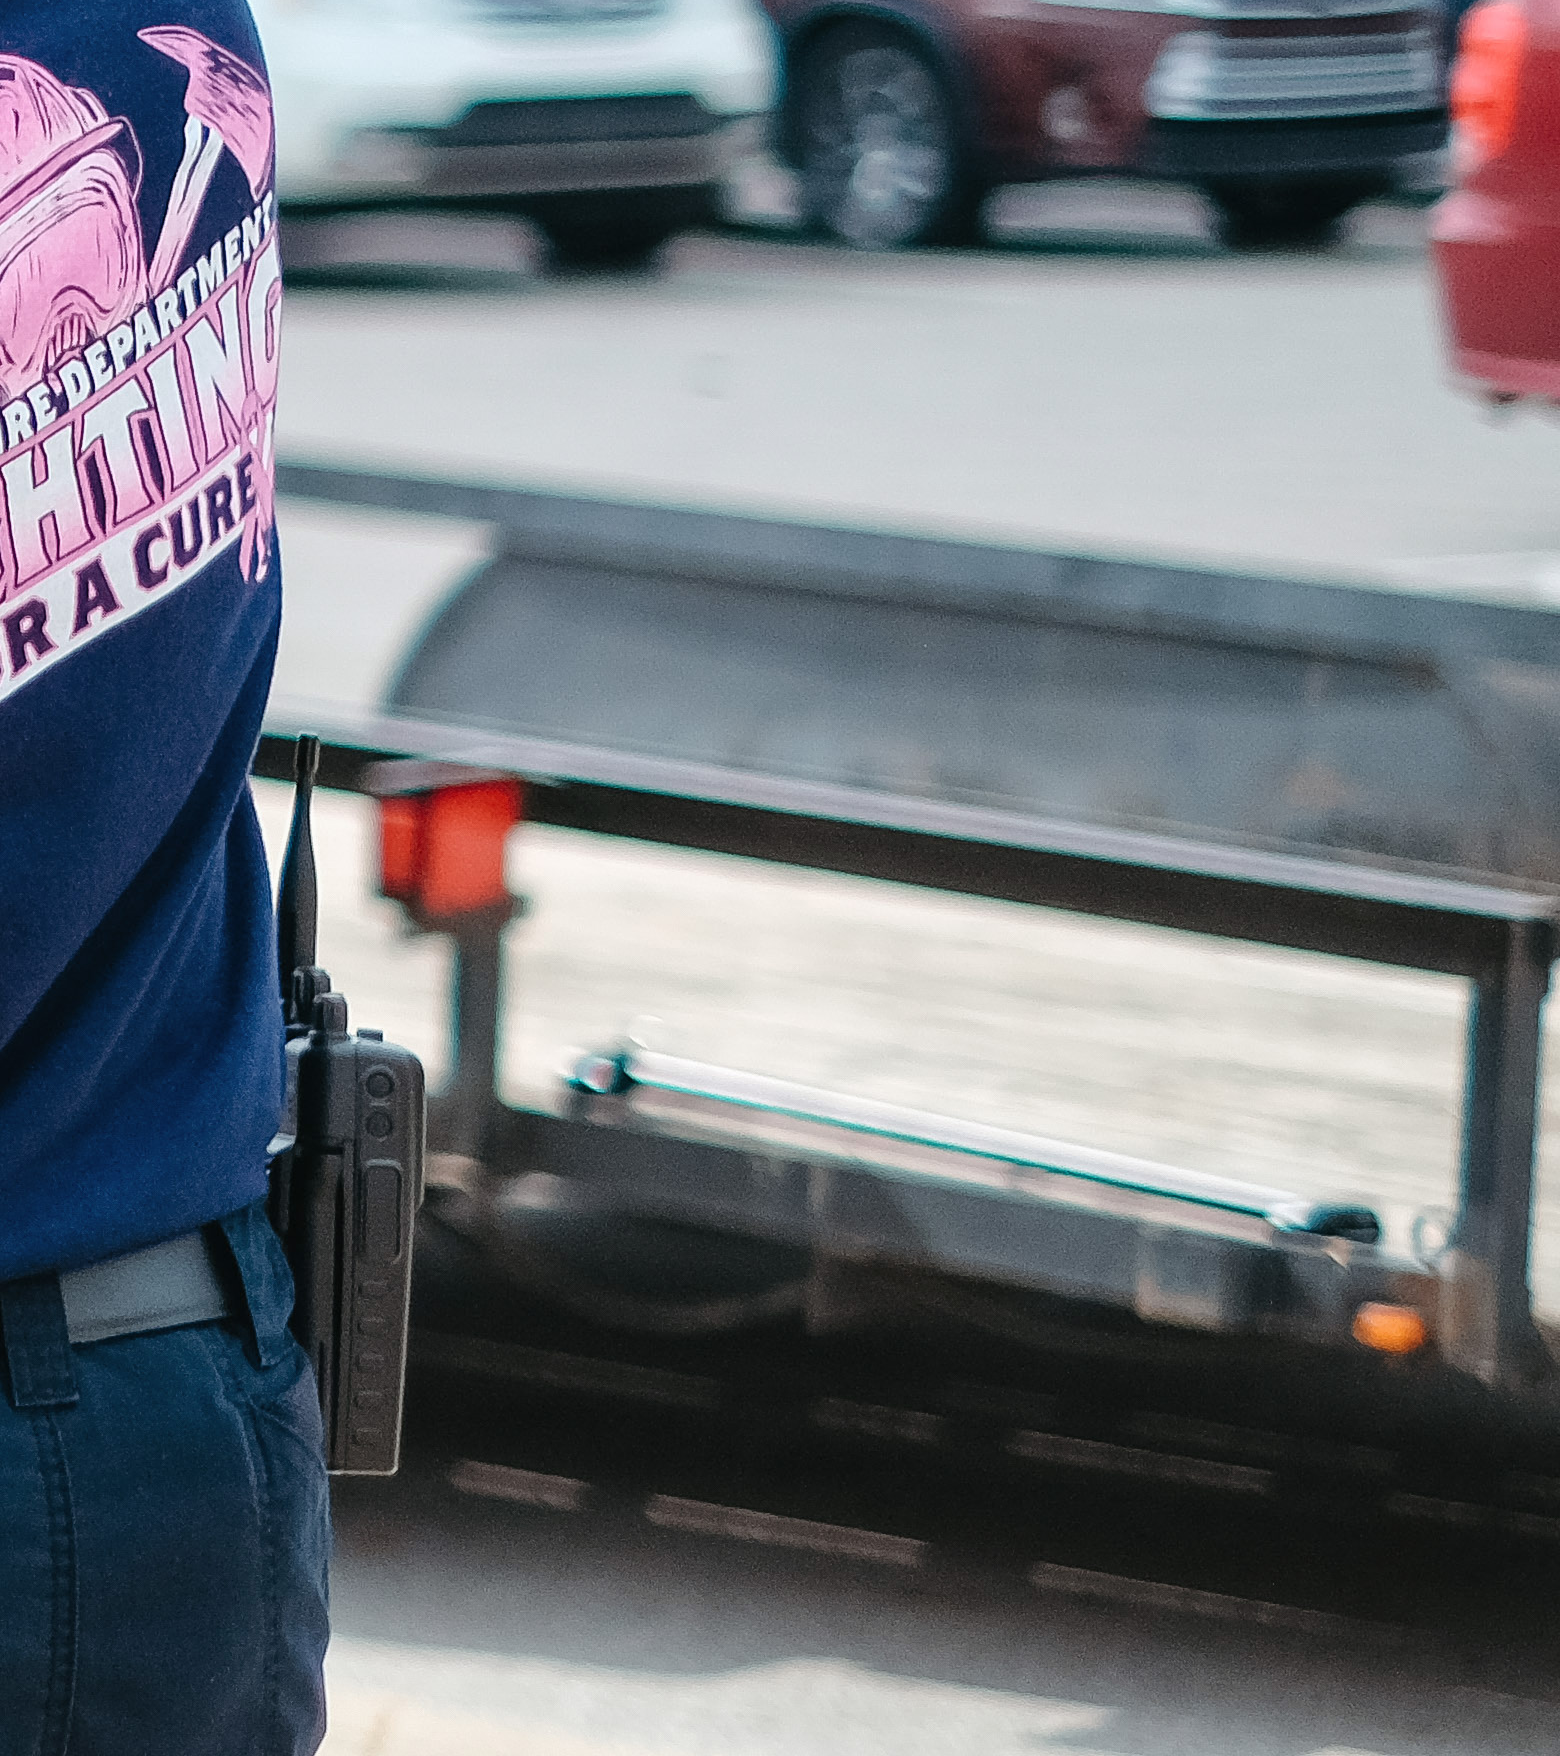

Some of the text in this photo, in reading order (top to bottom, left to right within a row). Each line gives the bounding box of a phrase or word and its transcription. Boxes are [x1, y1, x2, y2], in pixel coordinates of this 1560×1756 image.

[59, 190, 274, 410] DEPARTMENT
[71, 554, 123, 640] A
[132, 452, 258, 590] CURE
